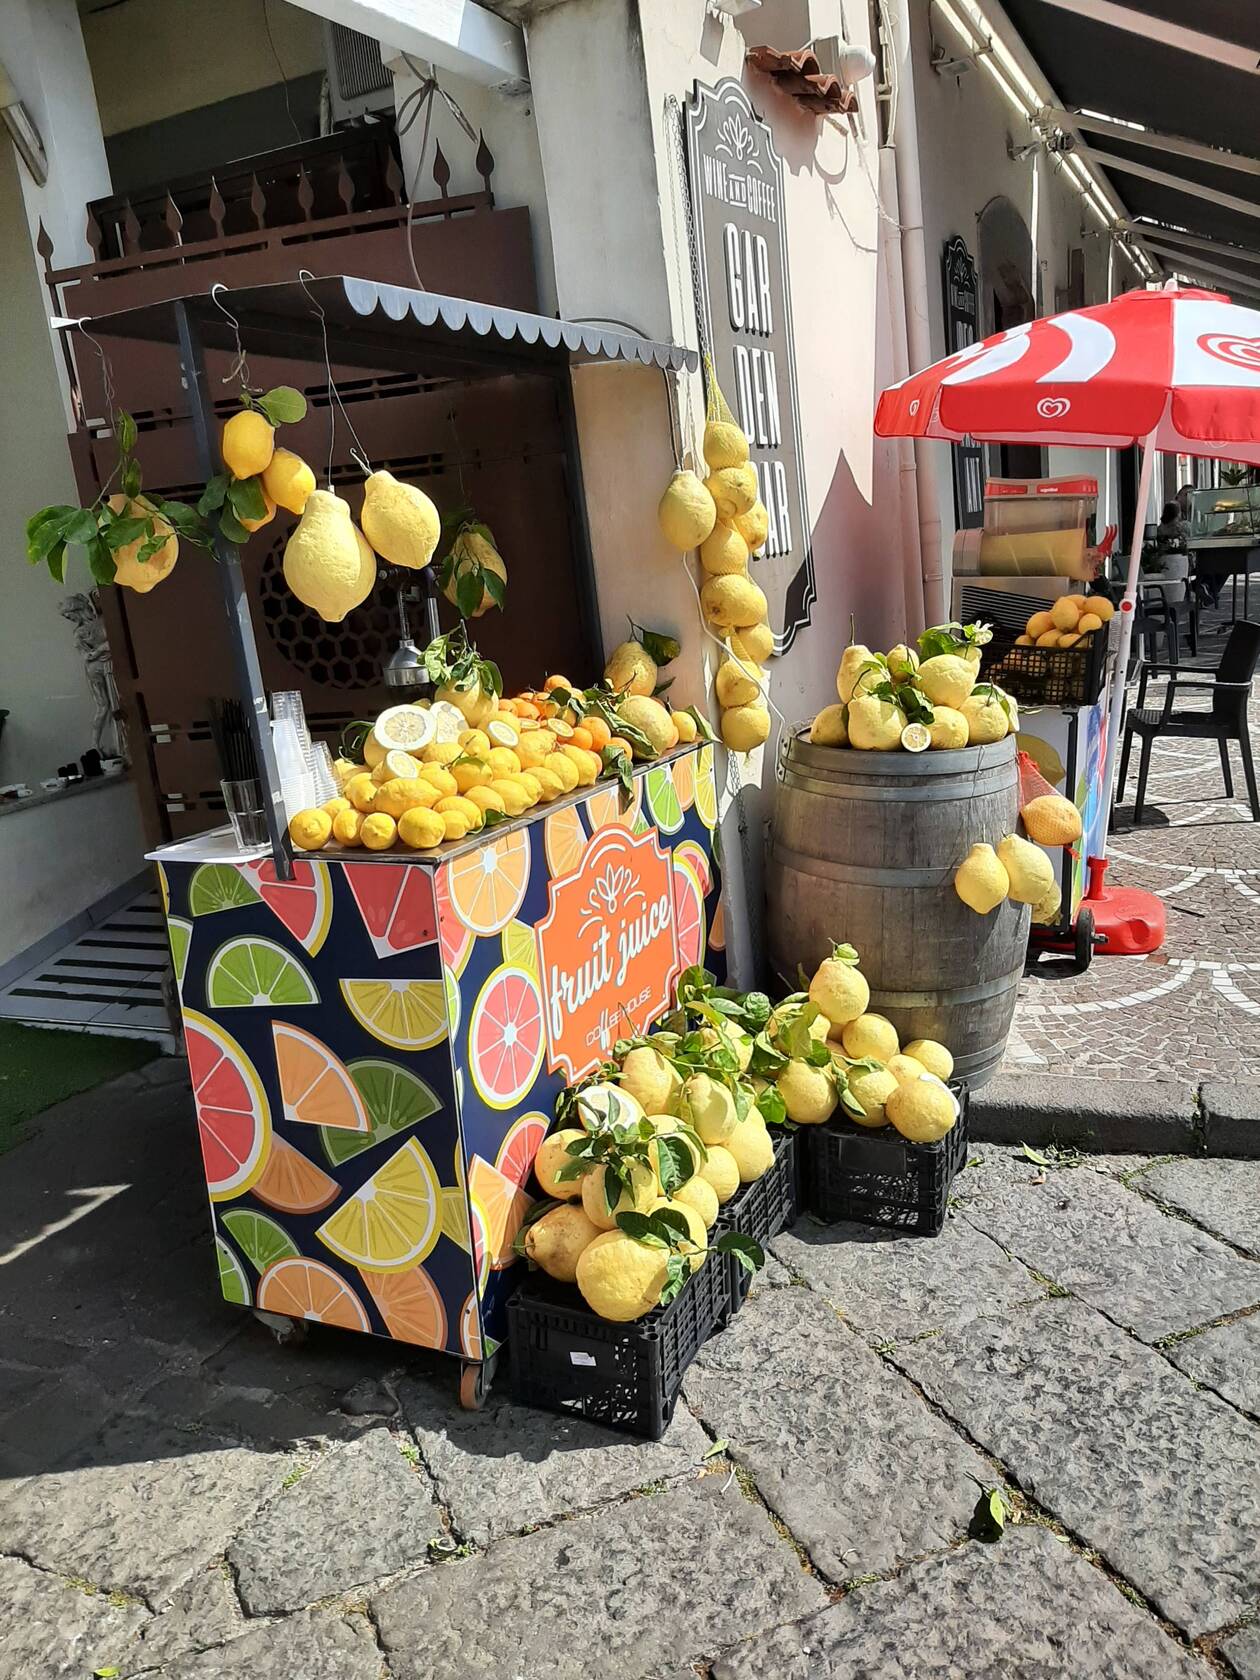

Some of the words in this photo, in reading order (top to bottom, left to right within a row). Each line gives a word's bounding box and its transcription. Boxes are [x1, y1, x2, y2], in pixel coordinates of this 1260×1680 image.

[703, 153, 729, 203] WINE
[729, 179, 747, 202] AND
[746, 174, 776, 223] COFFEE
[724, 222, 773, 336] GAR
[733, 344, 781, 447] DEN
[551, 925, 613, 1040] fruit
[617, 895, 671, 986] juice
